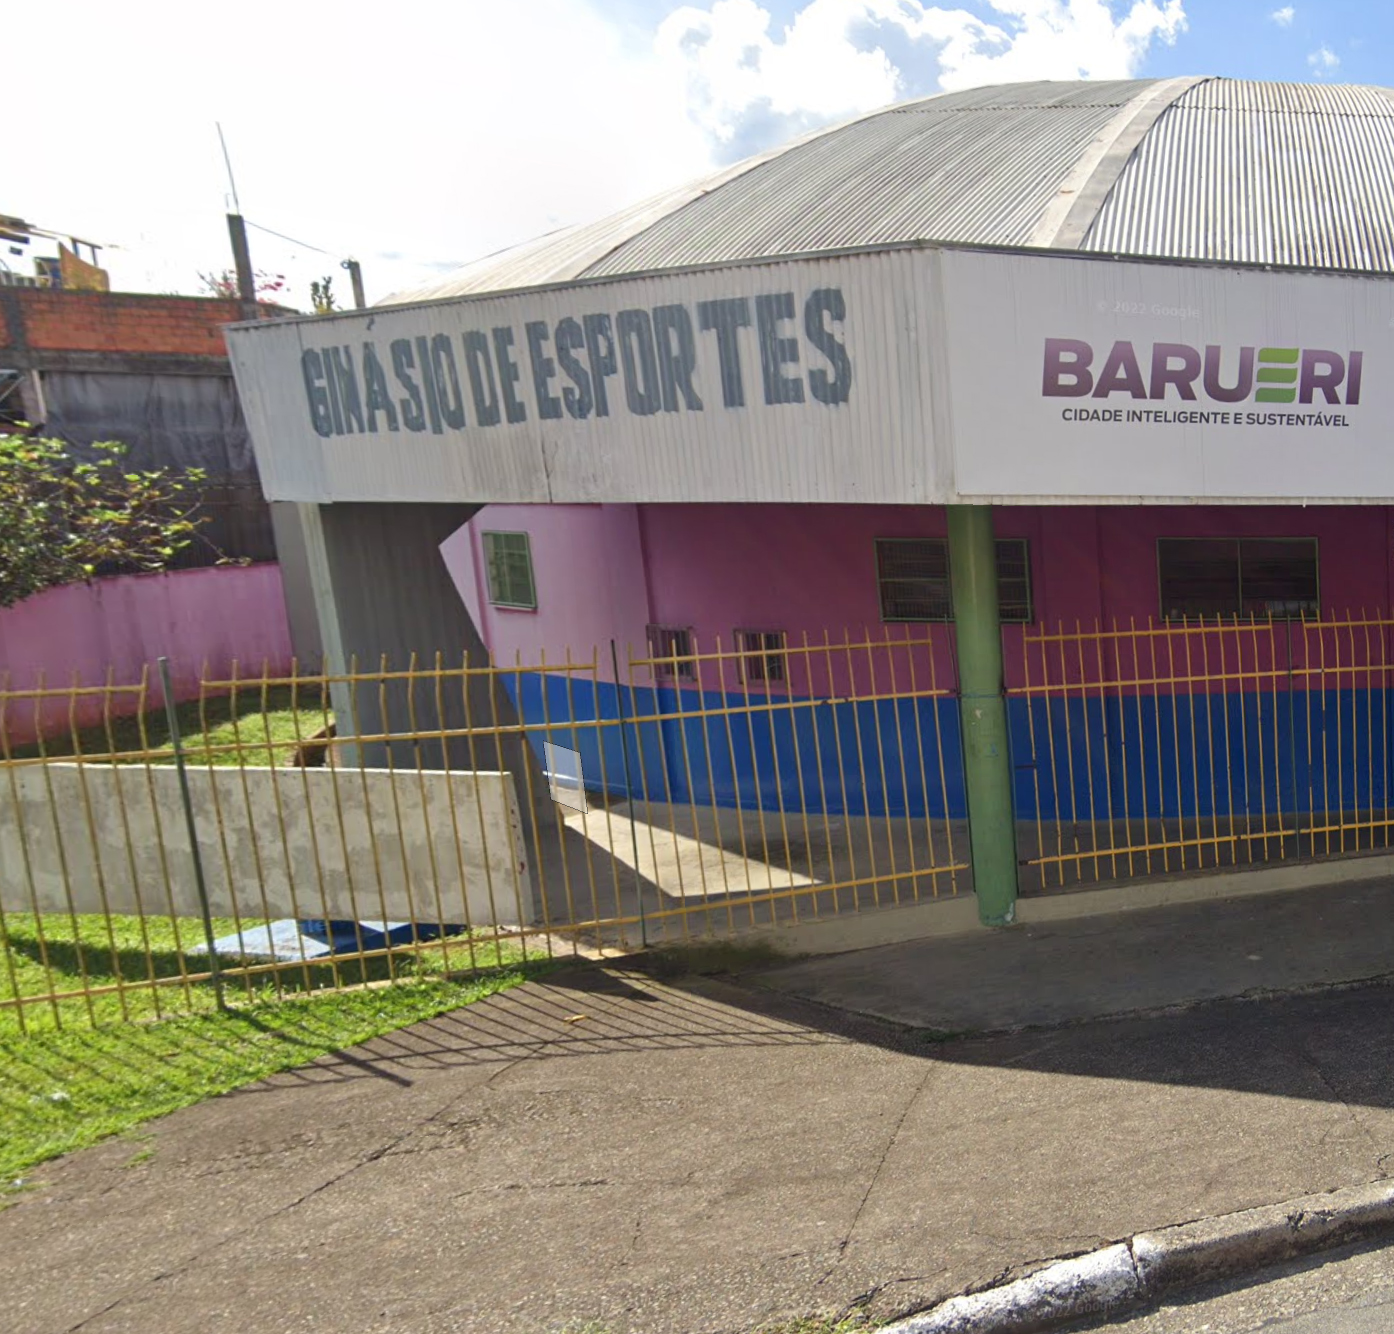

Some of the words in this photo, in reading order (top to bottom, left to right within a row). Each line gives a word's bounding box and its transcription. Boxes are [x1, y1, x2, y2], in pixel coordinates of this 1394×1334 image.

[462, 326, 526, 427] DE
[525, 288, 852, 420] ESPORTES
[1042, 338, 1364, 405] BARUERI
[1061, 408, 1122, 423] CIDADE
[1126, 410, 1230, 425] INTELIGENTE
[1233, 412, 1242, 425] E
[1246, 411, 1350, 427] SUSTENTÁVEL
